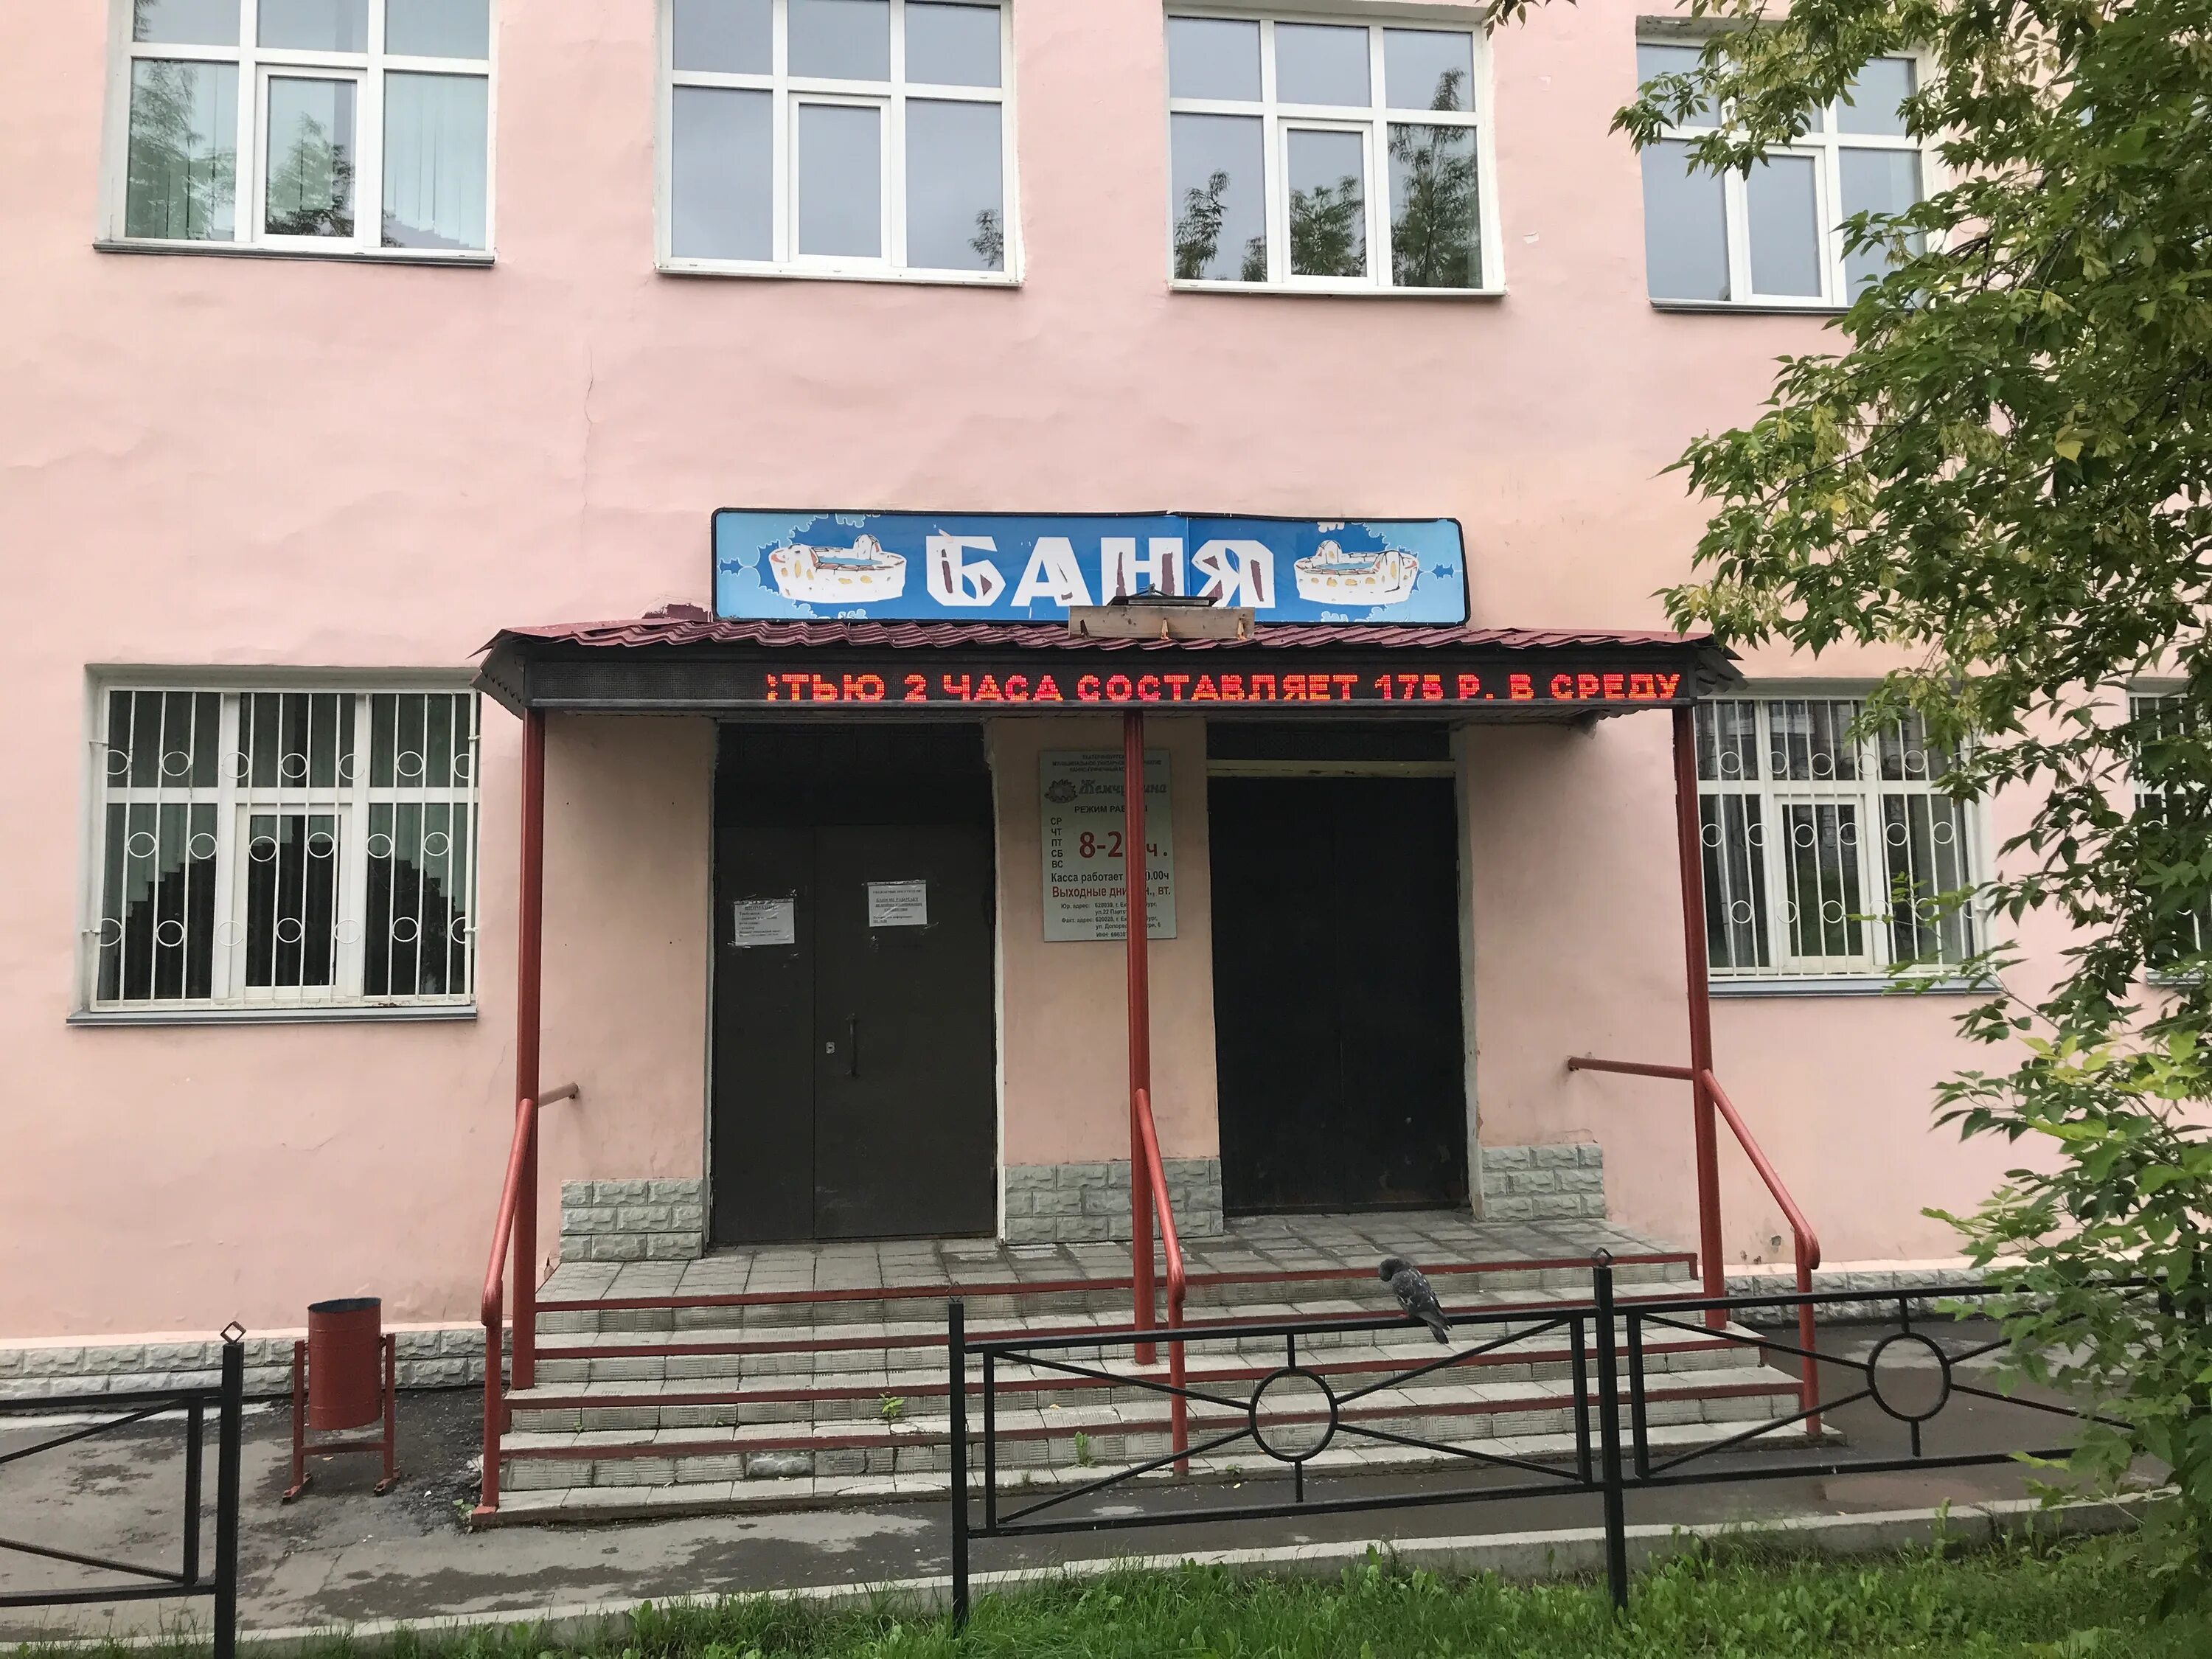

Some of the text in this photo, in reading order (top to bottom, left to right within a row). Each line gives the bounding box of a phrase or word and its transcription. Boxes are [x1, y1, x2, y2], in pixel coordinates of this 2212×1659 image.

[925, 535, 1276, 608] БАНЯ
[905, 675, 926, 703] 2
[944, 675, 1062, 703] ЧАСА
[1078, 675, 1357, 702] СОСТАВЛЯЕТ
[1375, 675, 1443, 701] 175
[1458, 675, 1493, 700] Р.
[1551, 674, 1680, 700] СРЕДУ
[1074, 805, 1107, 813] РЕЖИМ
[1051, 817, 1062, 825] СР
[1051, 828, 1062, 836] ЧТ
[1079, 831, 1124, 858] 8-2
[1051, 849, 1063, 858] СБ
[1051, 872, 1079, 882] Касса
[1081, 872, 1123, 883] работает
[1052, 886, 1107, 898] Выходные
